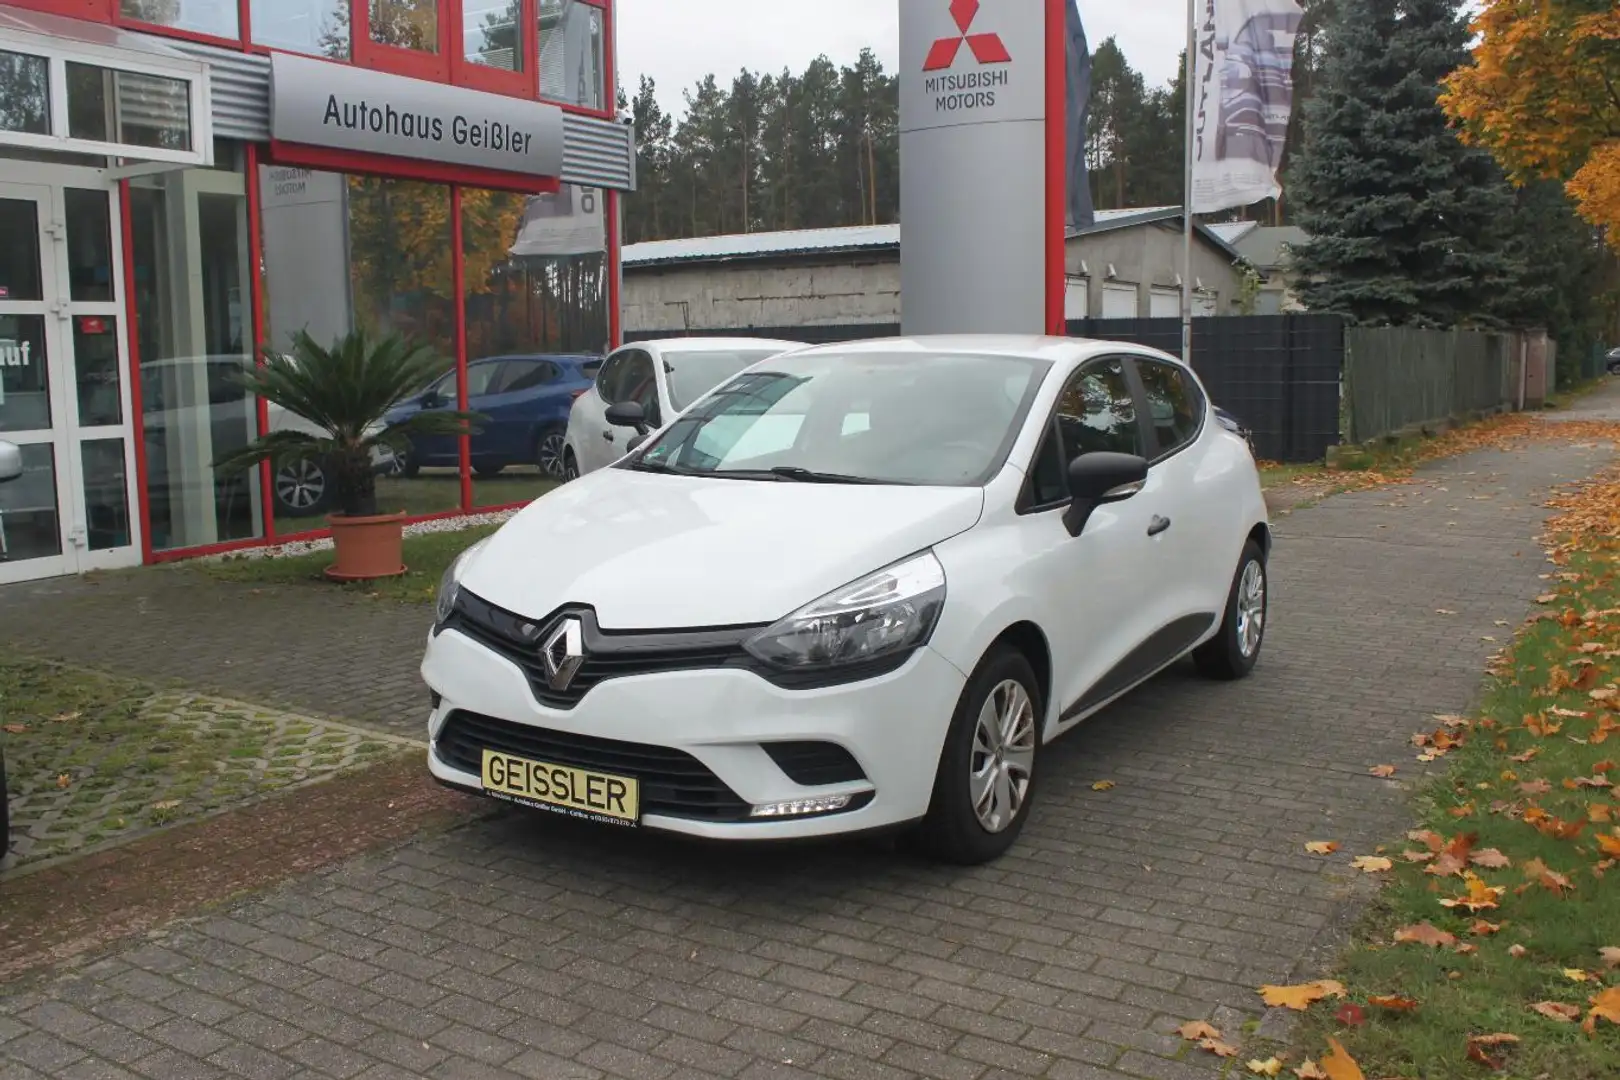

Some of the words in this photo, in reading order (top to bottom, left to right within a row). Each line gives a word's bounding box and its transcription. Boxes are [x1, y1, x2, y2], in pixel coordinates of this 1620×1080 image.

[925, 69, 1008, 93] MITSUBISHI
[935, 91, 995, 111] MOTORS
[323, 93, 443, 142] Autohaus
[451, 114, 533, 156] Geißler
[489, 755, 627, 813] GEISSLER
